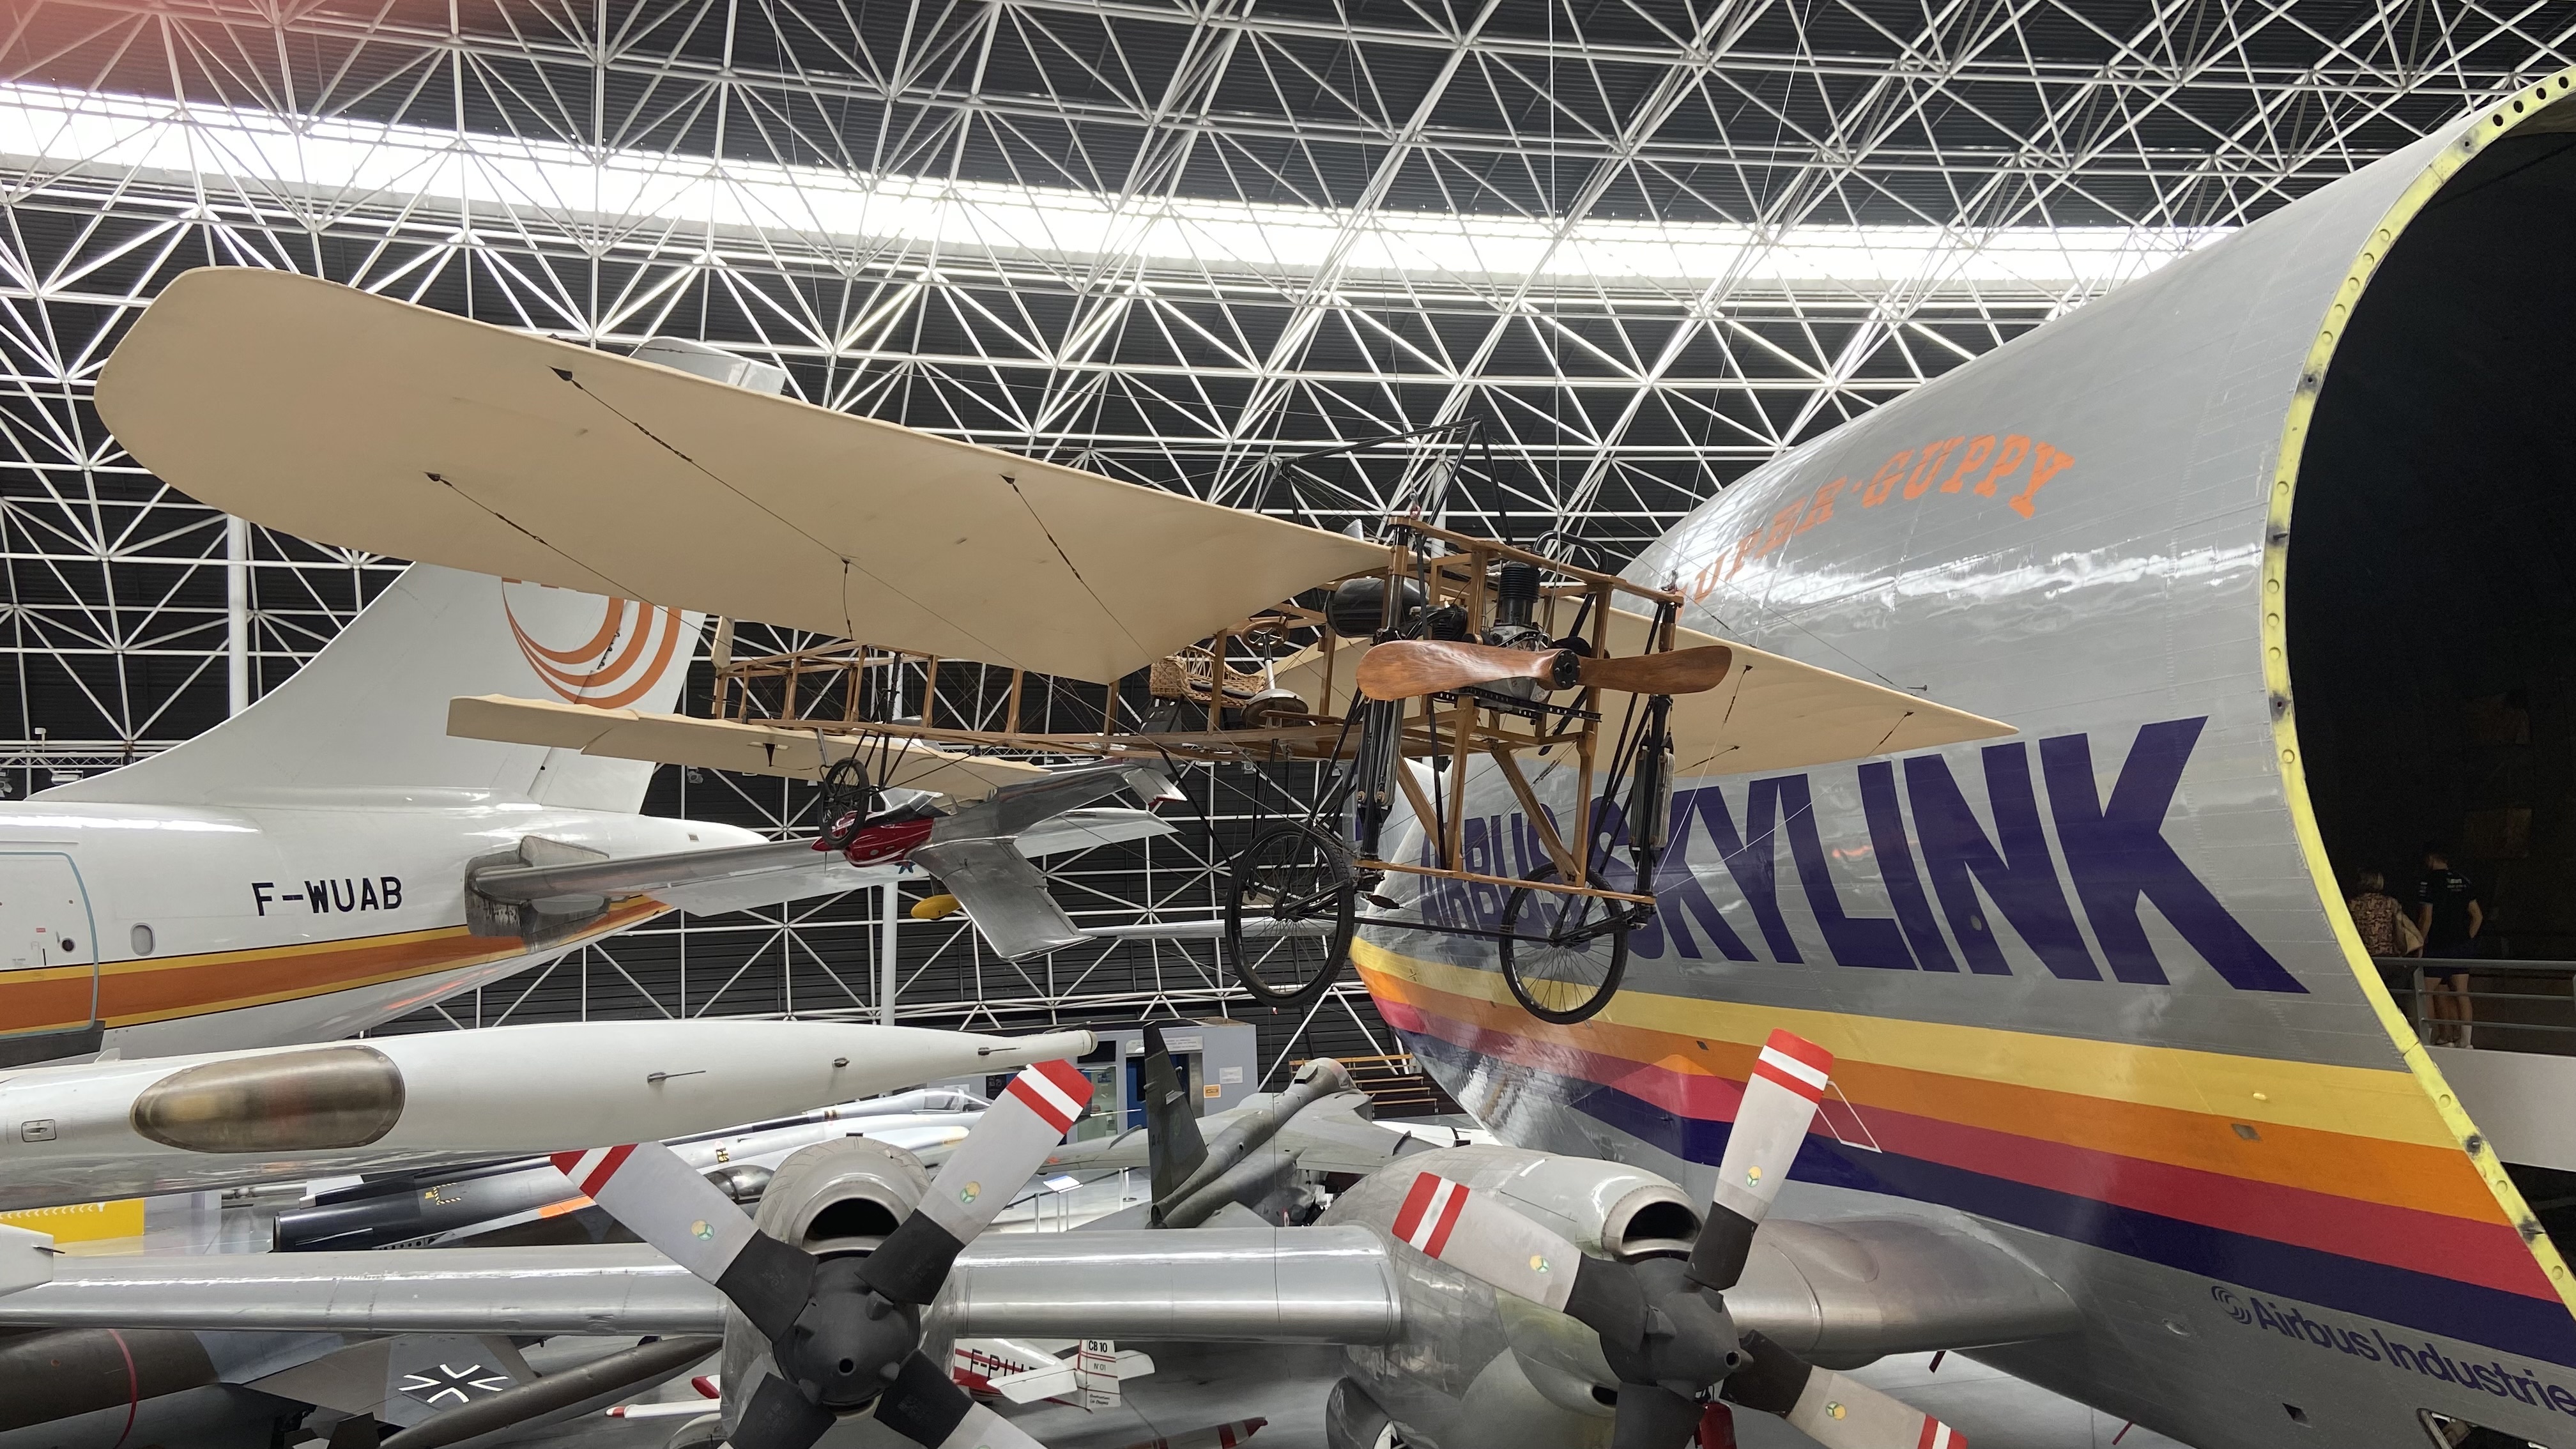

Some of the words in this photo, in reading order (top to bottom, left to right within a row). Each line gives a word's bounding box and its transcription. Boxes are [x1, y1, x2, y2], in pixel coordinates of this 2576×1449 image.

[252, 876, 402, 916] F-WUAB
[1089, 1340, 1098, 1351] CB
[1100, 1342, 1107, 1353] 10
[2250, 1297, 2382, 1361] Airbus
[2371, 1329, 2576, 1416] Industrie
